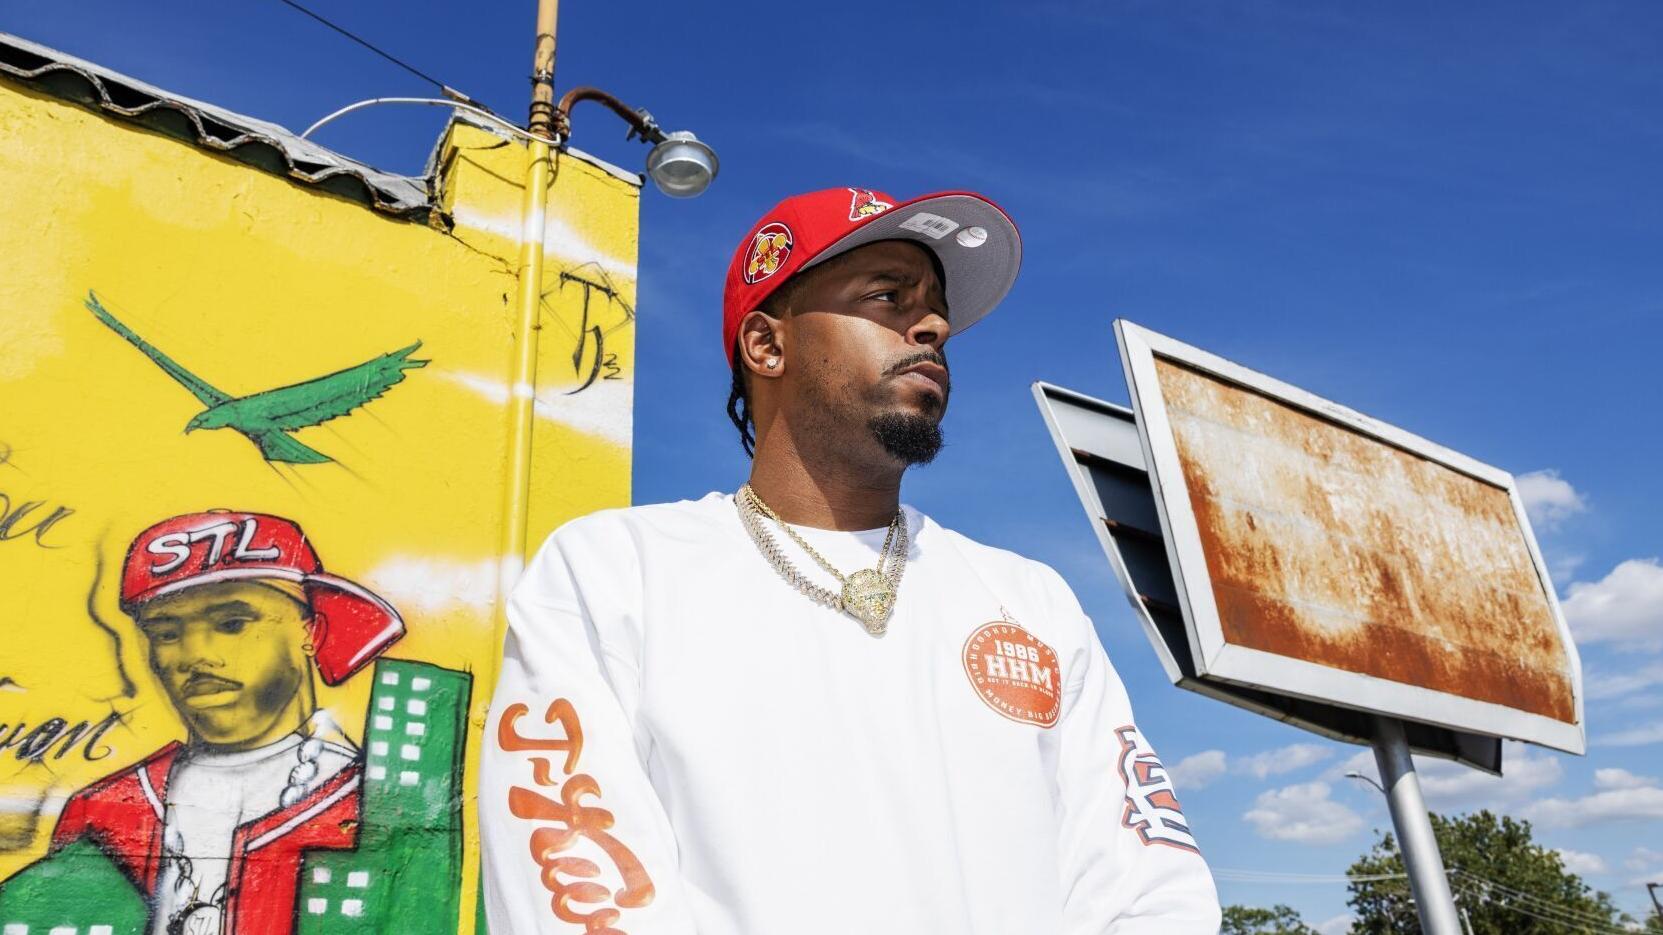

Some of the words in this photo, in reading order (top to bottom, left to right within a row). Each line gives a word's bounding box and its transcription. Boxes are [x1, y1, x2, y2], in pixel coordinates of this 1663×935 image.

[147, 518, 280, 576] STL
[994, 639, 1040, 663] 1986
[984, 654, 1054, 691] HHM
[985, 688, 1022, 715] MONEY
